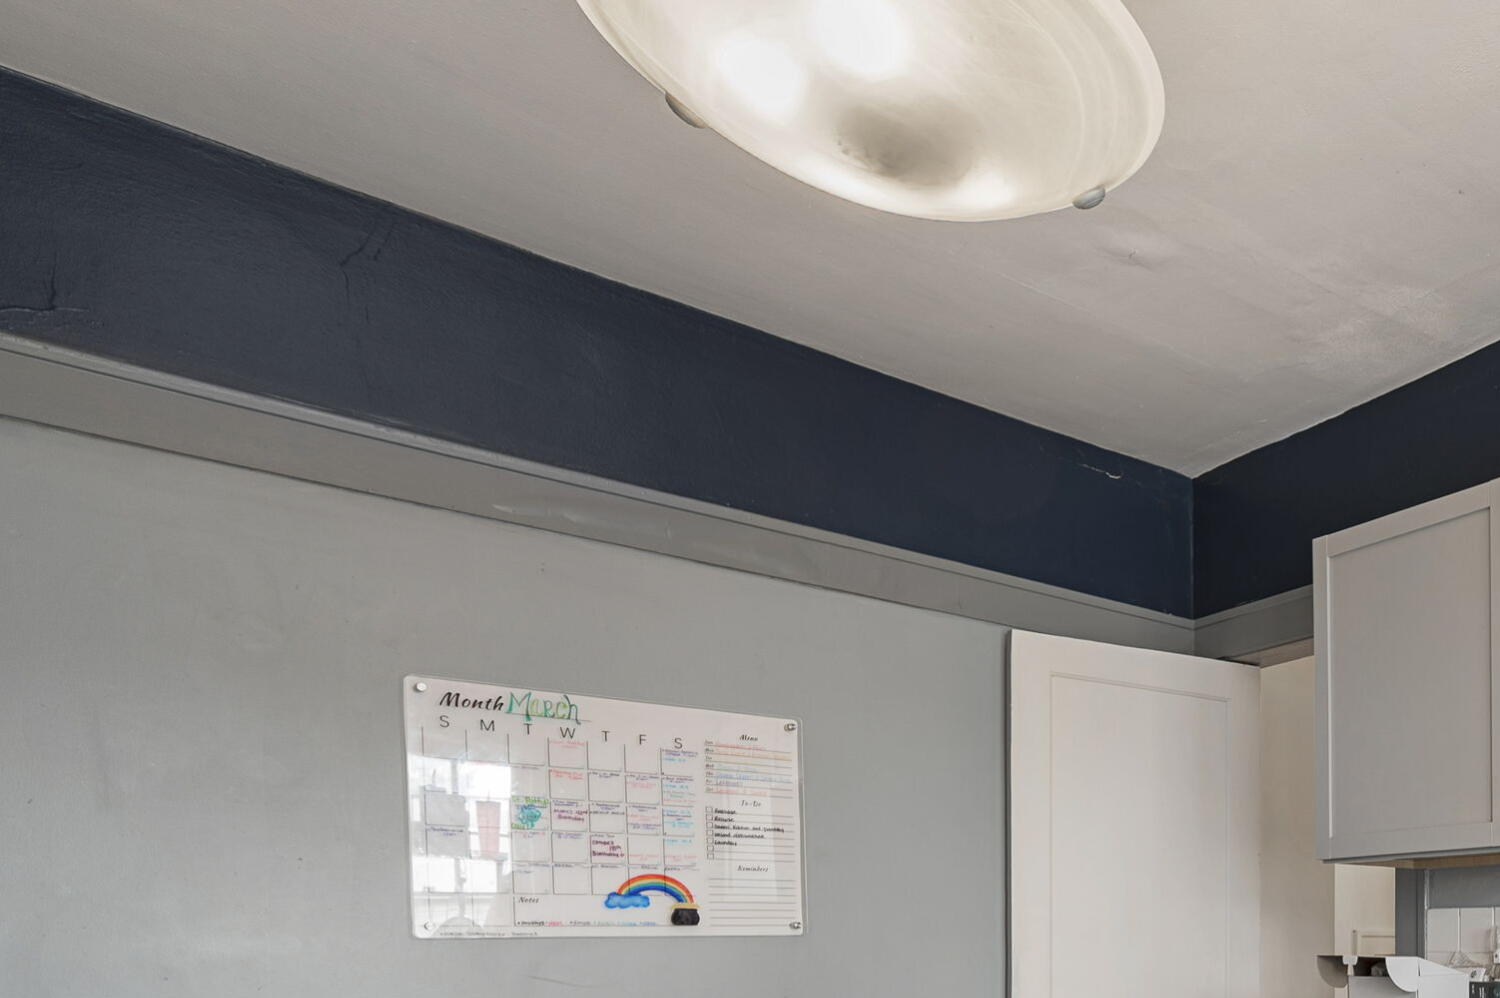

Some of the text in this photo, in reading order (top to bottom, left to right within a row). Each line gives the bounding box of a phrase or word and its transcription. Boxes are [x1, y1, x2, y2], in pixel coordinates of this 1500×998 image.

[439, 691, 505, 712] Month
[439, 714, 683, 750] S M T W T F S
